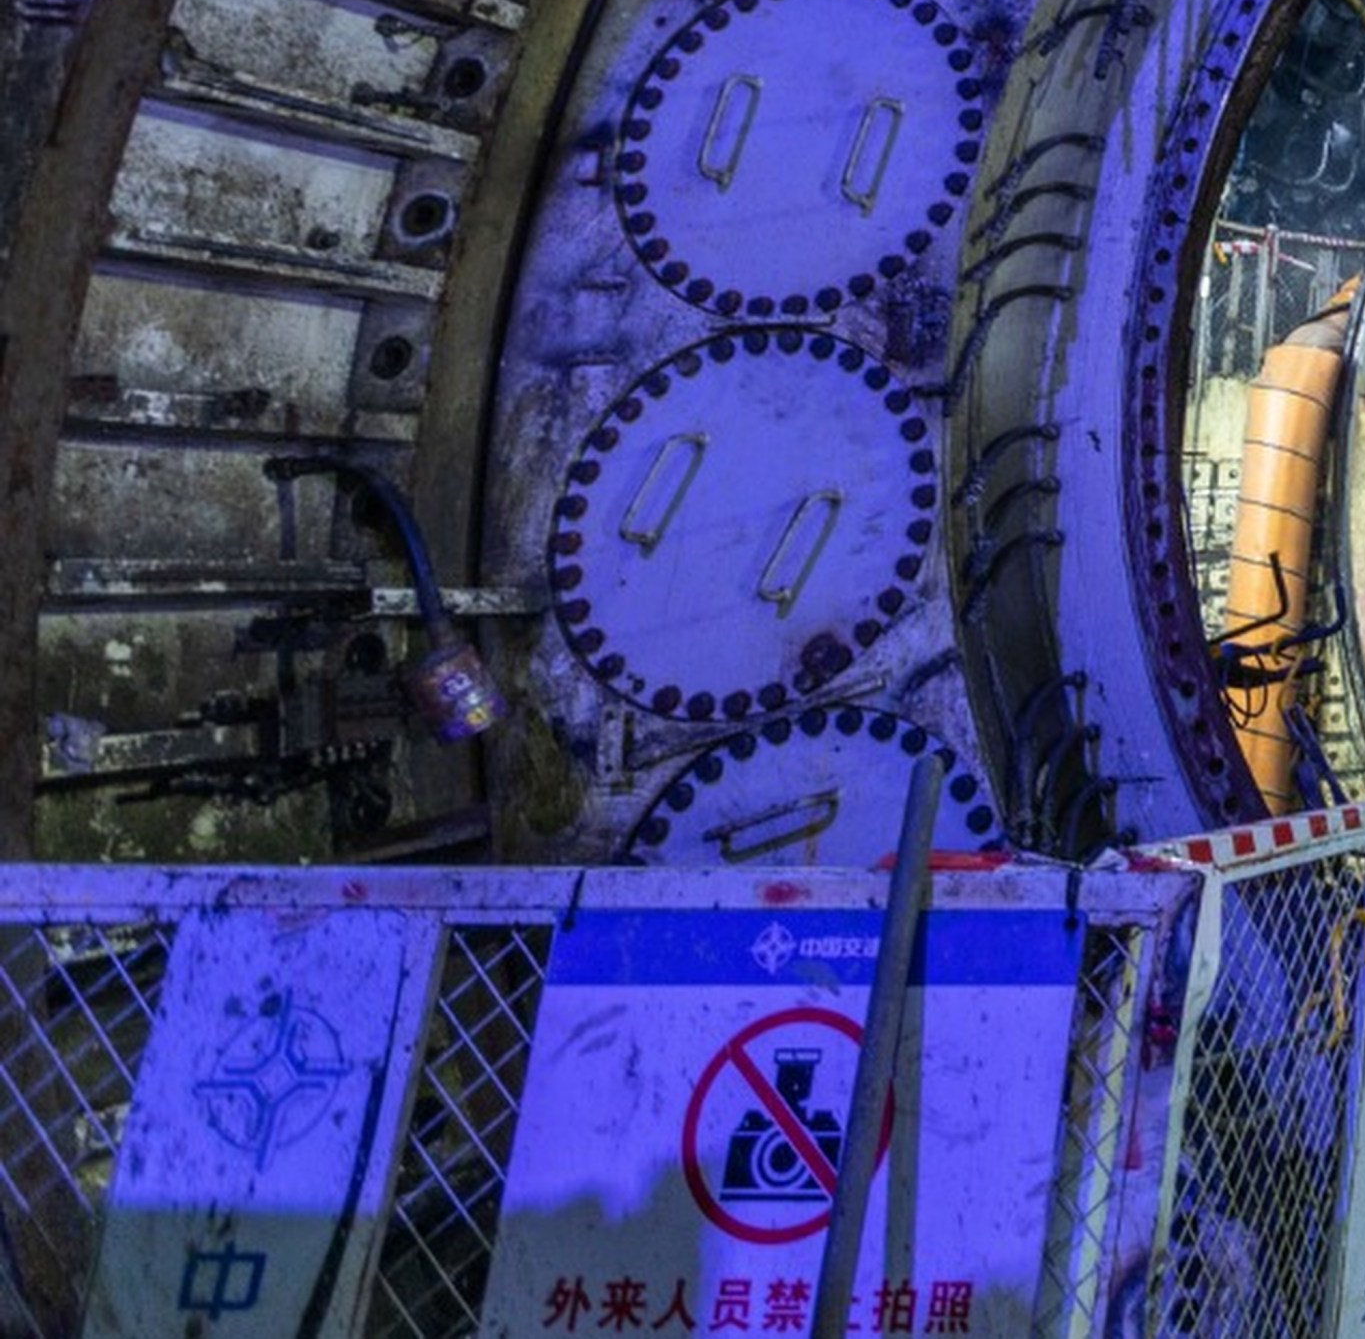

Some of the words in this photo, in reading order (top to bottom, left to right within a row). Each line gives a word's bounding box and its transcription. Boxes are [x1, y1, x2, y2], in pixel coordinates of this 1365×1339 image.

[178, 1240, 267, 1322] 中
[542, 1276, 973, 1333] 外来人员禁拍照
